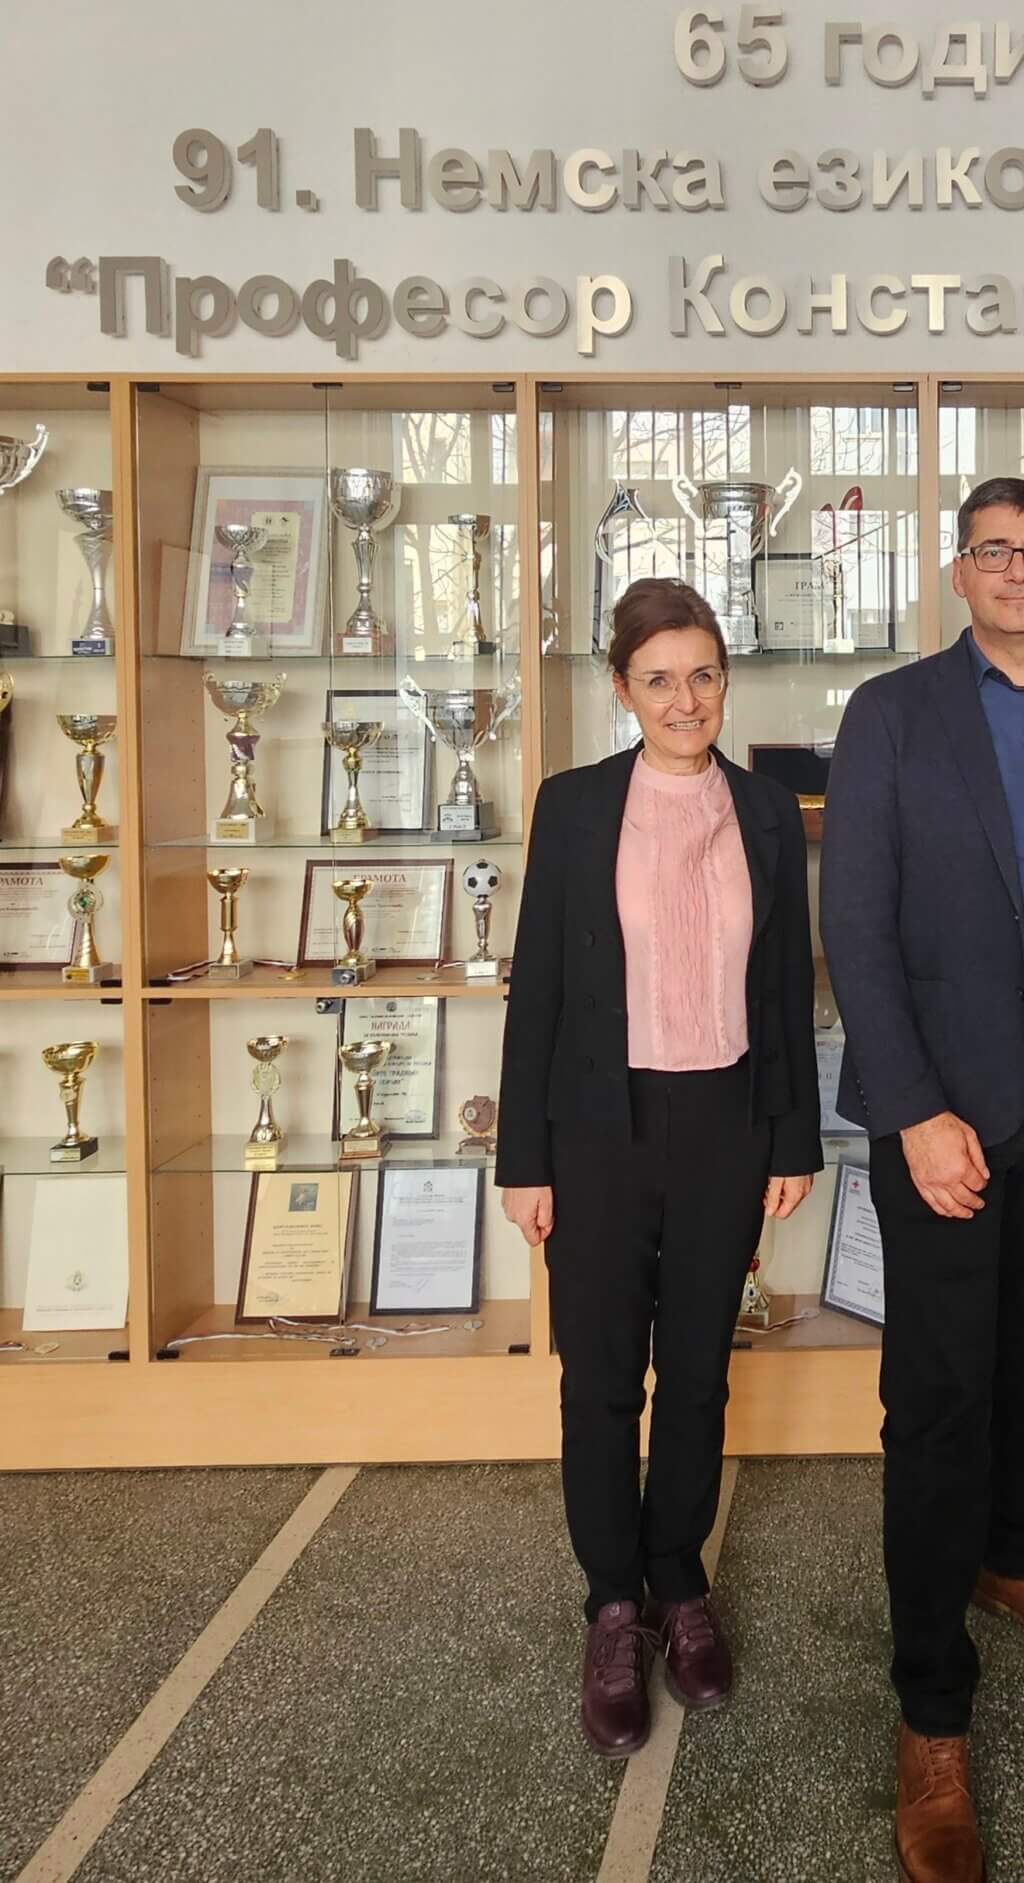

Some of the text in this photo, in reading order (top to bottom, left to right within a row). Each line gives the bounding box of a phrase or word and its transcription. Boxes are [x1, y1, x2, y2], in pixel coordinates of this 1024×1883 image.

[673, 5, 789, 87] 65
[172, 127, 320, 212] 91.
[354, 127, 725, 212] Немска
